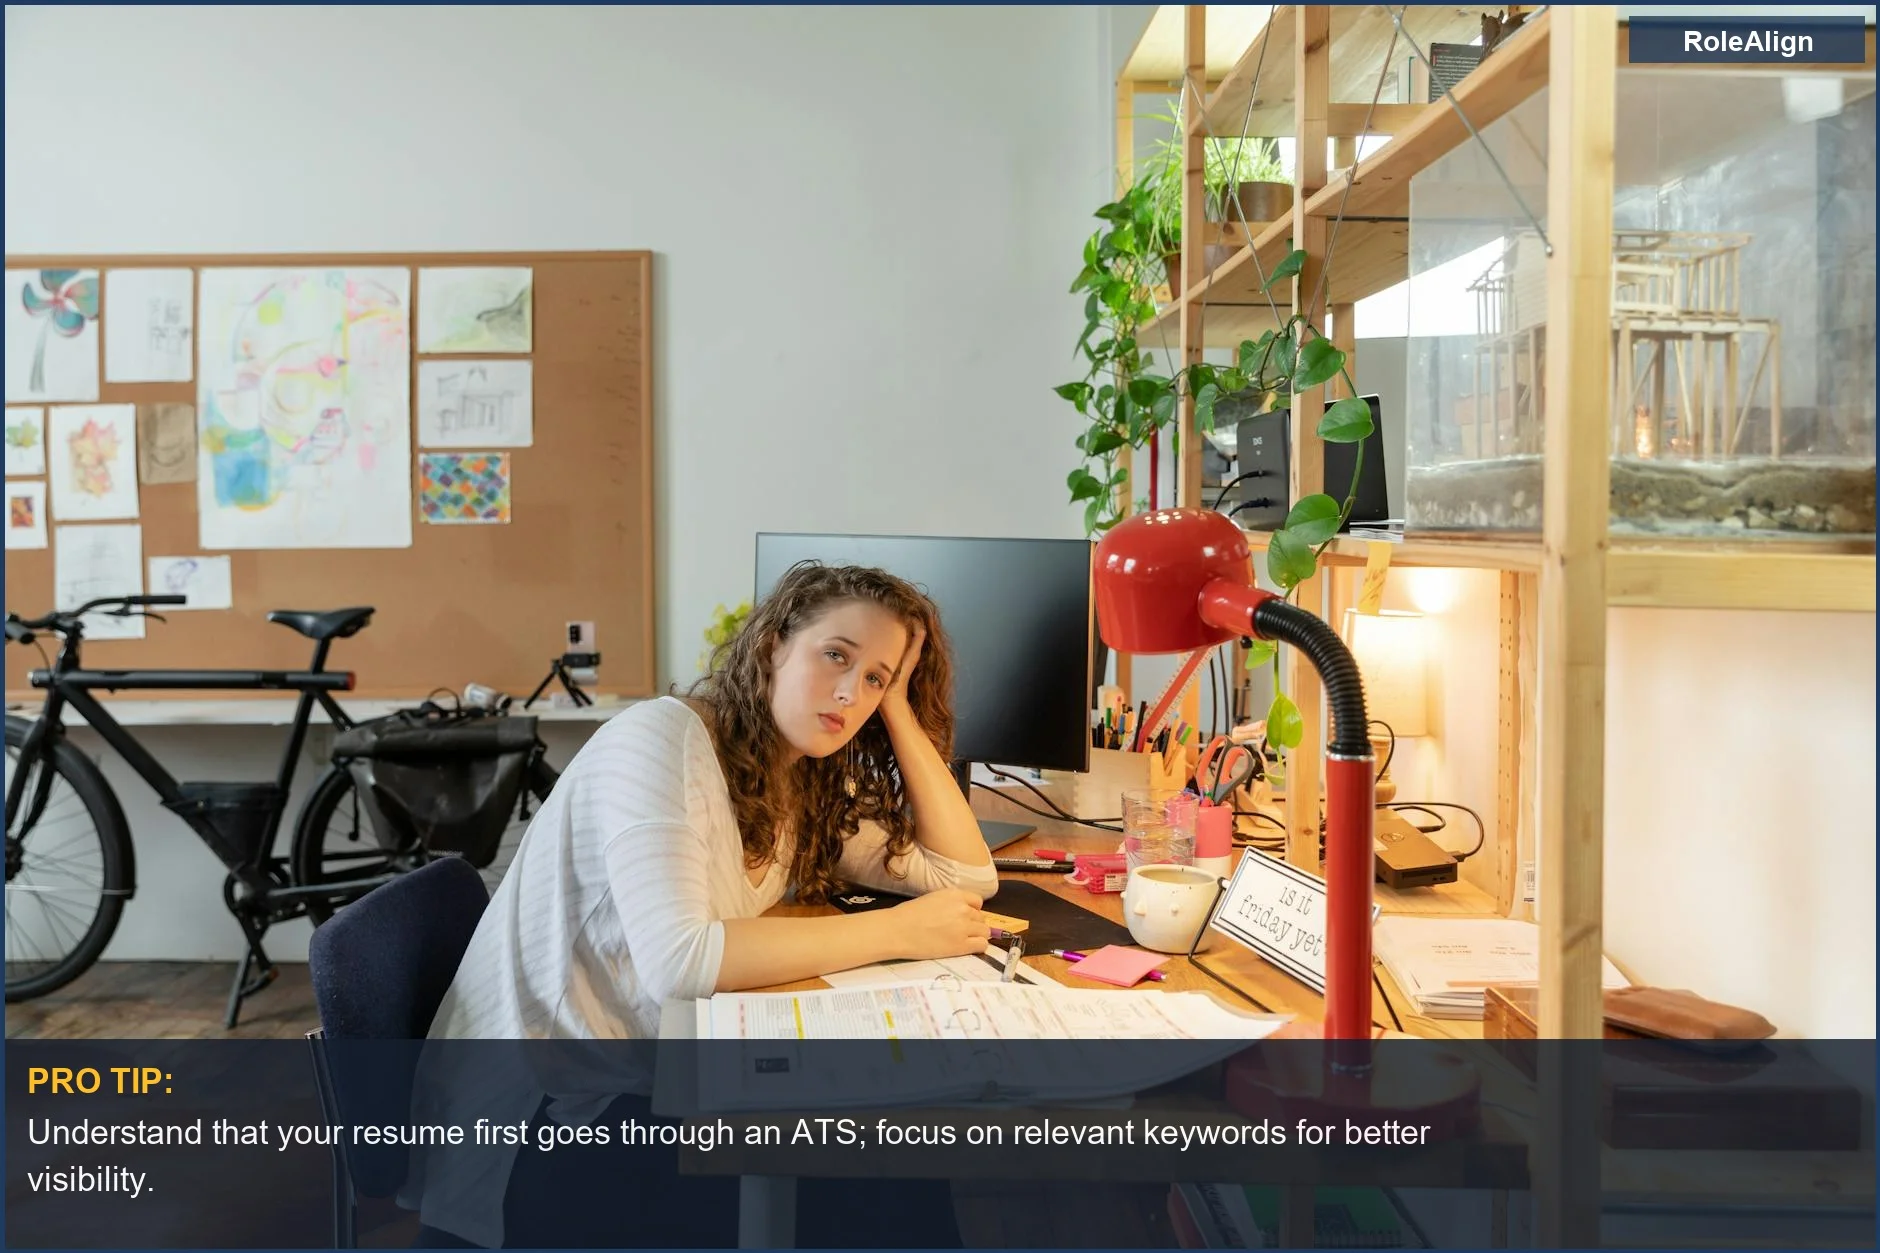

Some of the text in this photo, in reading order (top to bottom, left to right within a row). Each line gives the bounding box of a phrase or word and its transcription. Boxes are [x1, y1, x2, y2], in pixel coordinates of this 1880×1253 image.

[1279, 885, 1313, 916] is it
[1237, 894, 1326, 957] friday yet
